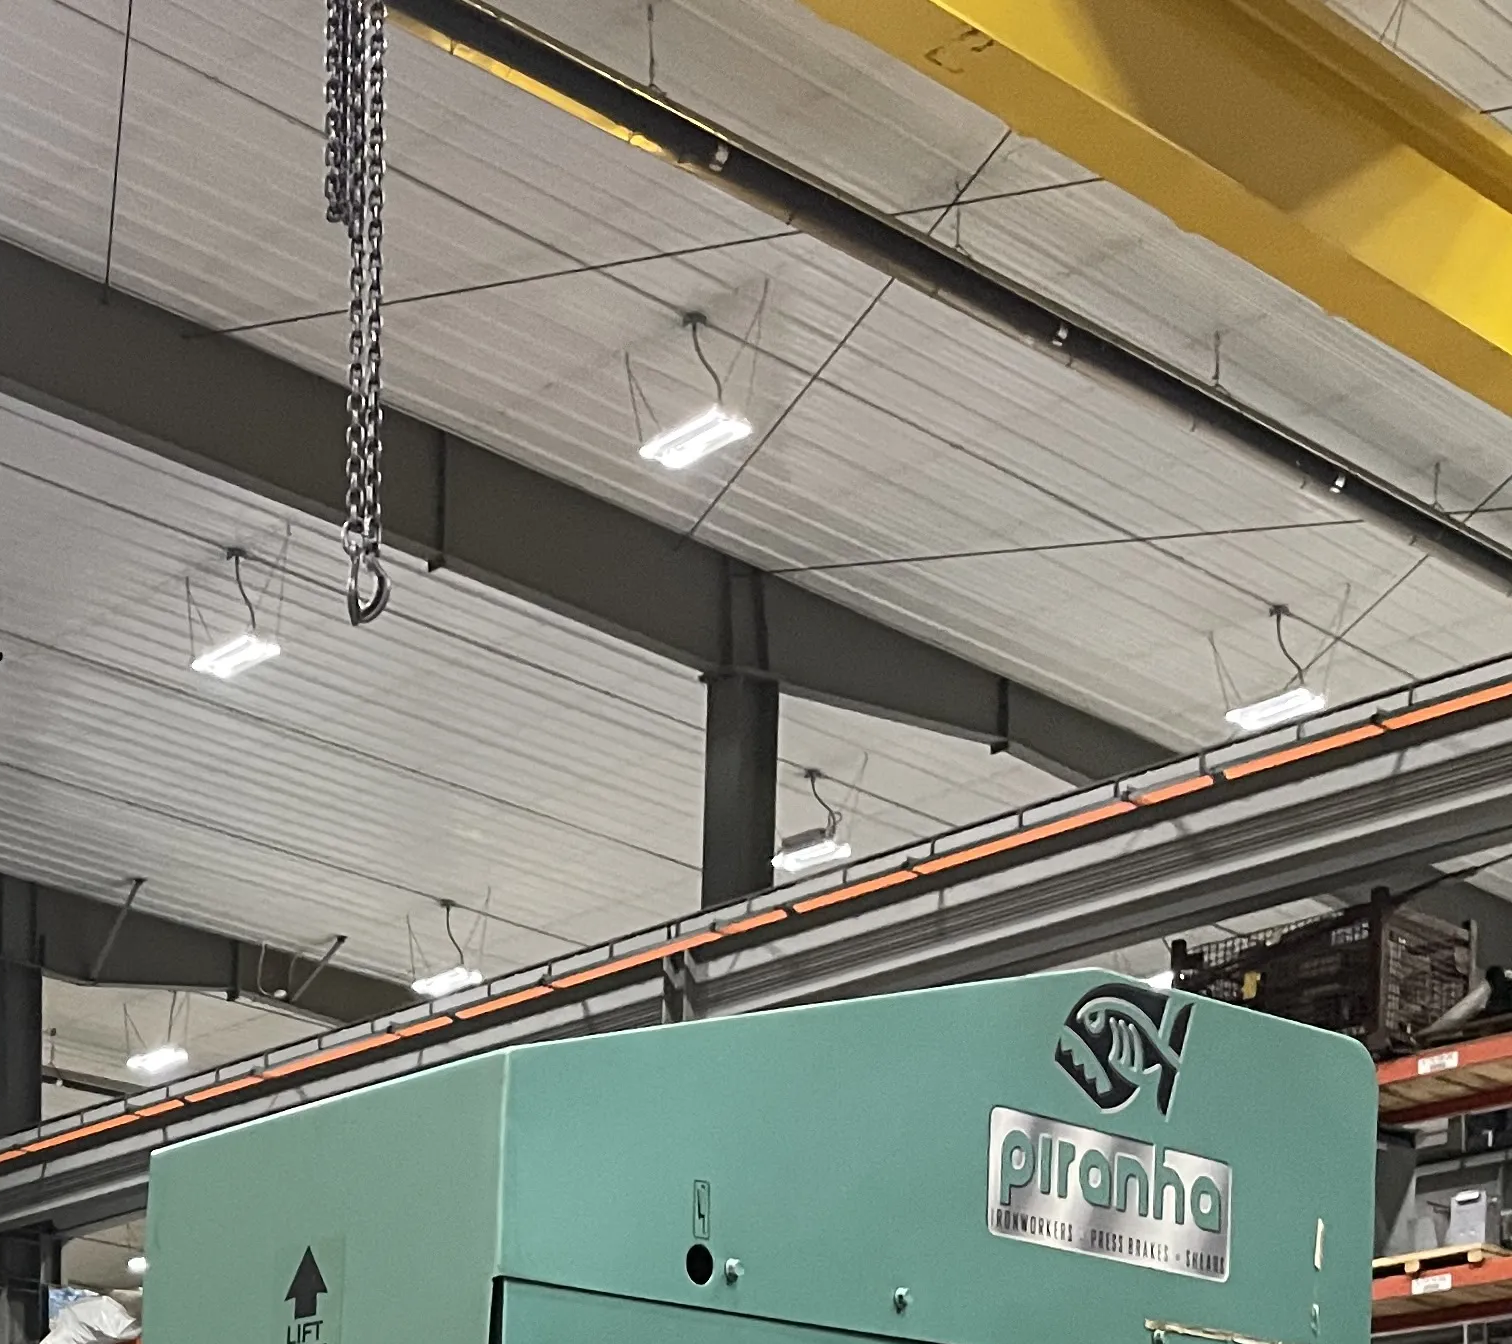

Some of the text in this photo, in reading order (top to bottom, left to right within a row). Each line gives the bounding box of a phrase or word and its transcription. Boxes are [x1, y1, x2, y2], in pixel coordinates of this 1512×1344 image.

[999, 1129, 1222, 1233] piranha
[990, 1208, 1225, 1275] IRONWORKERS PRESS BRAKES SHEARS
